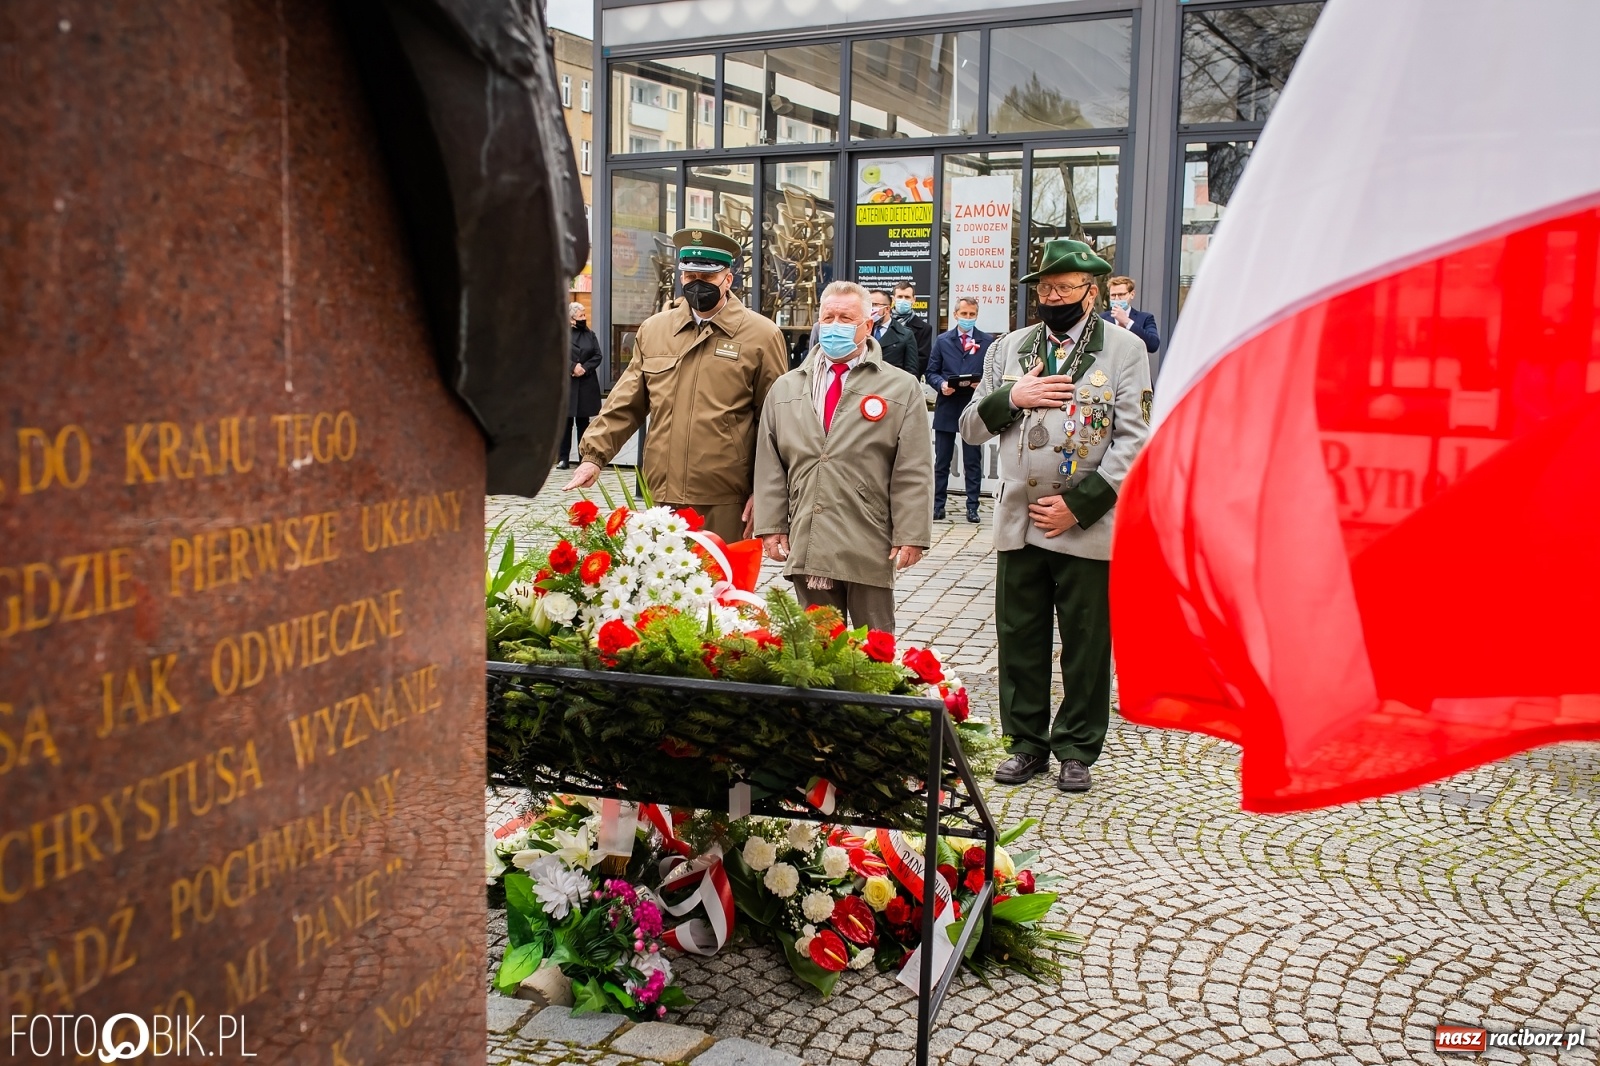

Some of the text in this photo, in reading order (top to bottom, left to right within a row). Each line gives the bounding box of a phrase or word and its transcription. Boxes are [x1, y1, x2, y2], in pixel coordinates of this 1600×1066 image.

[858, 206, 931, 223] CATERING DIETETYCZNY
[955, 200, 1010, 218] ZAMÓW
[888, 228, 931, 238] BEZ PSZENICY
[956, 223, 1008, 232] Z DOWOZEM
[972, 235, 990, 244] LUB
[958, 248, 1005, 257] ODBIOREM
[957, 260, 1004, 269] W LOKALU
[955, 284, 1006, 293] 32 415 84 84
[982, 296, 993, 304] 74
[995, 296, 1005, 304] 75
[17, 411, 357, 495] DO KRAJU TEGO
[170, 511, 339, 598] PIERWSZE
[361, 490, 464, 553] UKŁONY
[97, 653, 183, 739] JAK
[211, 589, 403, 697] ODWIECZNE
[0, 663, 442, 904] CHRYSTUSA WYZNANIE
[225, 936, 270, 1015] MI
